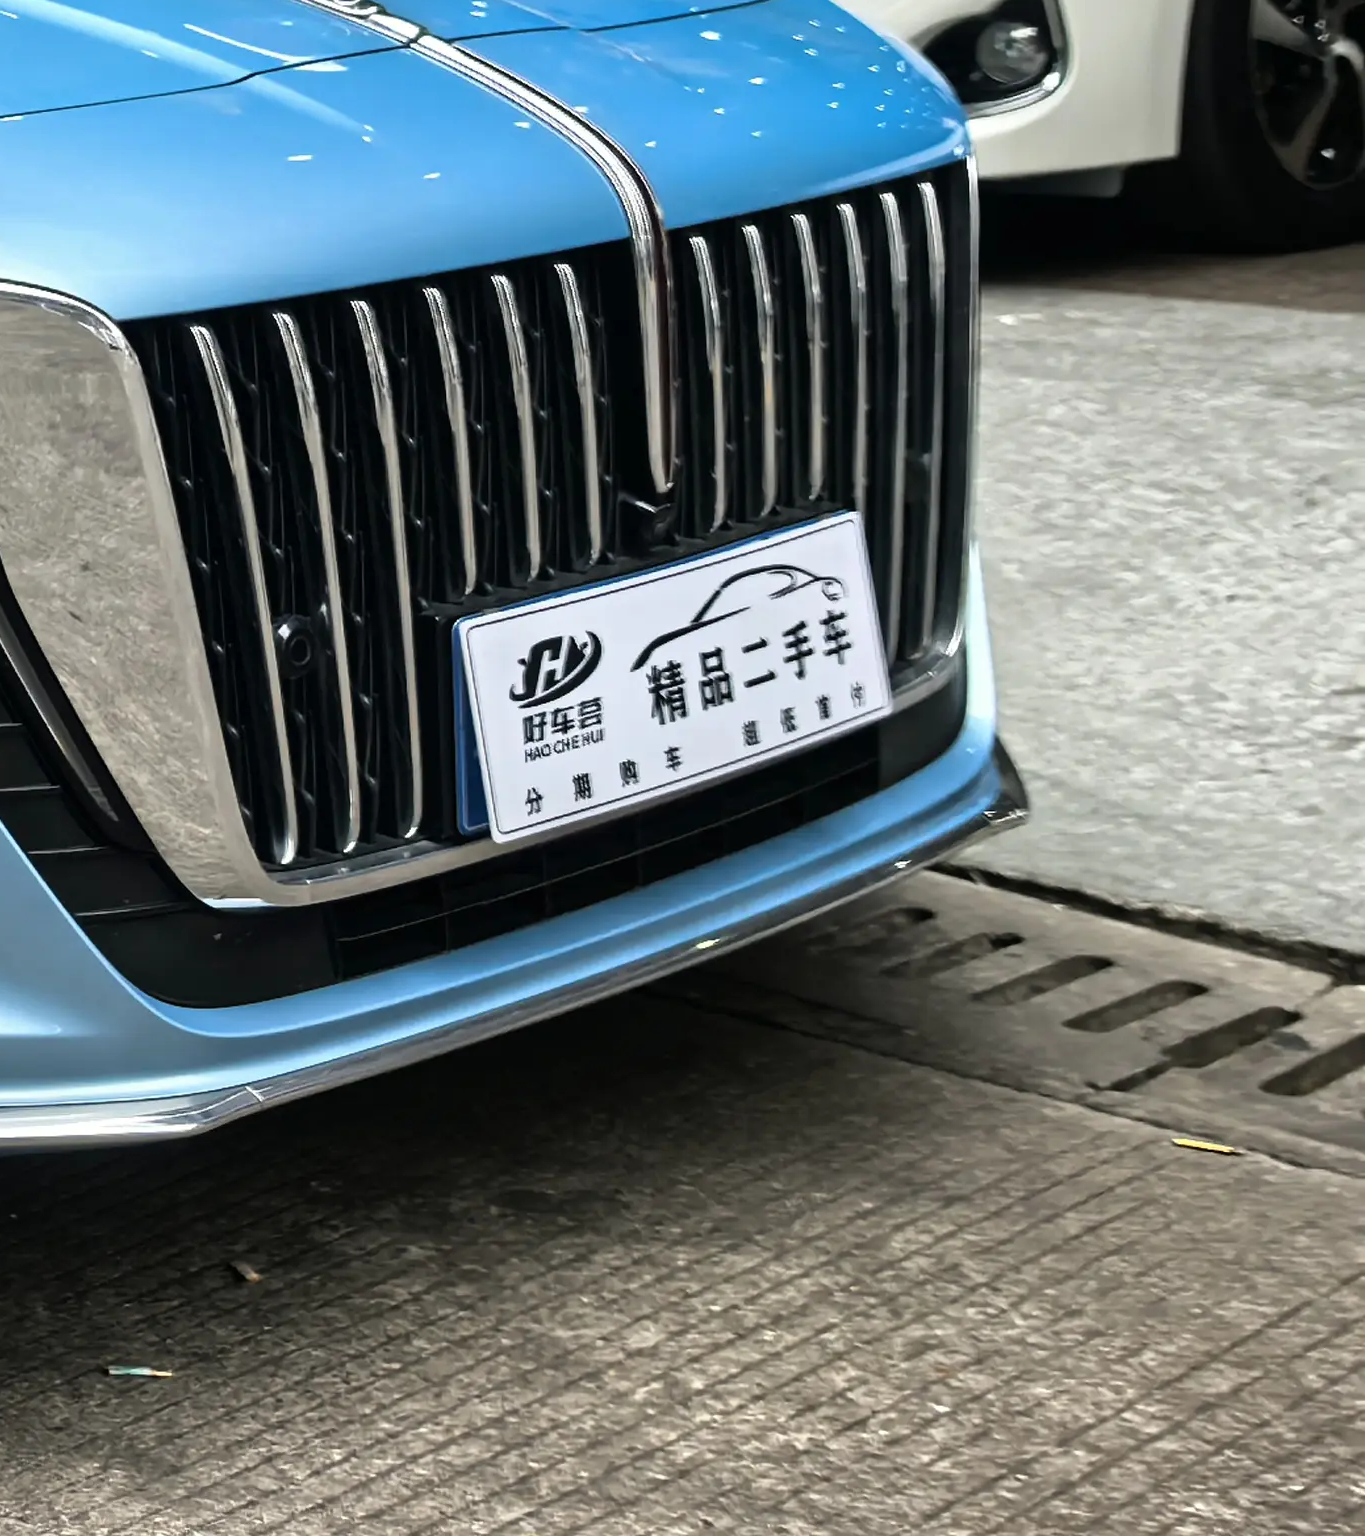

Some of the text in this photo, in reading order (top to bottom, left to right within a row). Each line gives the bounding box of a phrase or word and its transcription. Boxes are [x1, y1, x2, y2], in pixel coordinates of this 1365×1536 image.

[647, 608, 854, 725] 精品二手车
